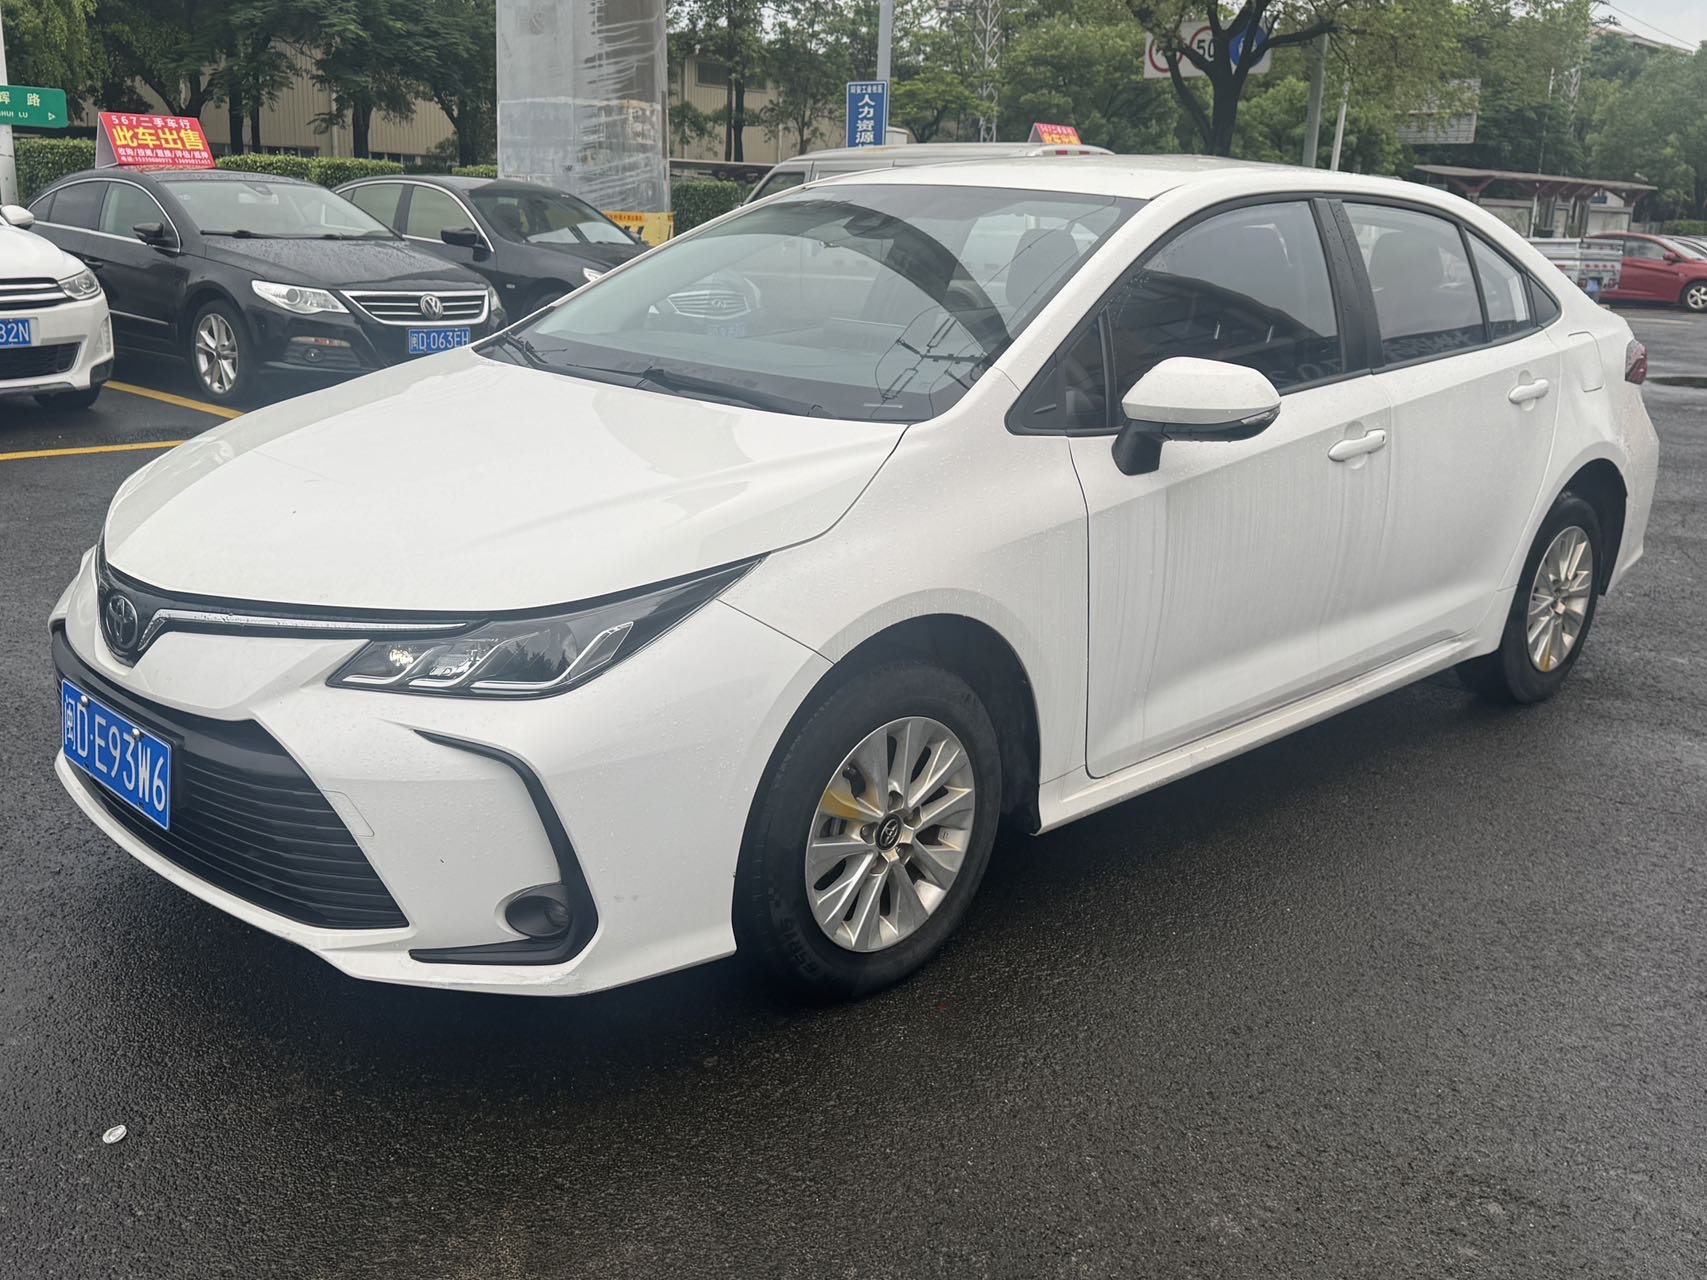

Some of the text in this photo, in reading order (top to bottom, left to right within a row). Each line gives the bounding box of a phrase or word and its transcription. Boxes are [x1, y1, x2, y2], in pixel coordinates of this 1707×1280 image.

[18, 111, 29, 119] LU
[111, 115, 191, 129] 567二手车行
[855, 94, 876, 148] 人力资源
[112, 126, 205, 151] 此车出售
